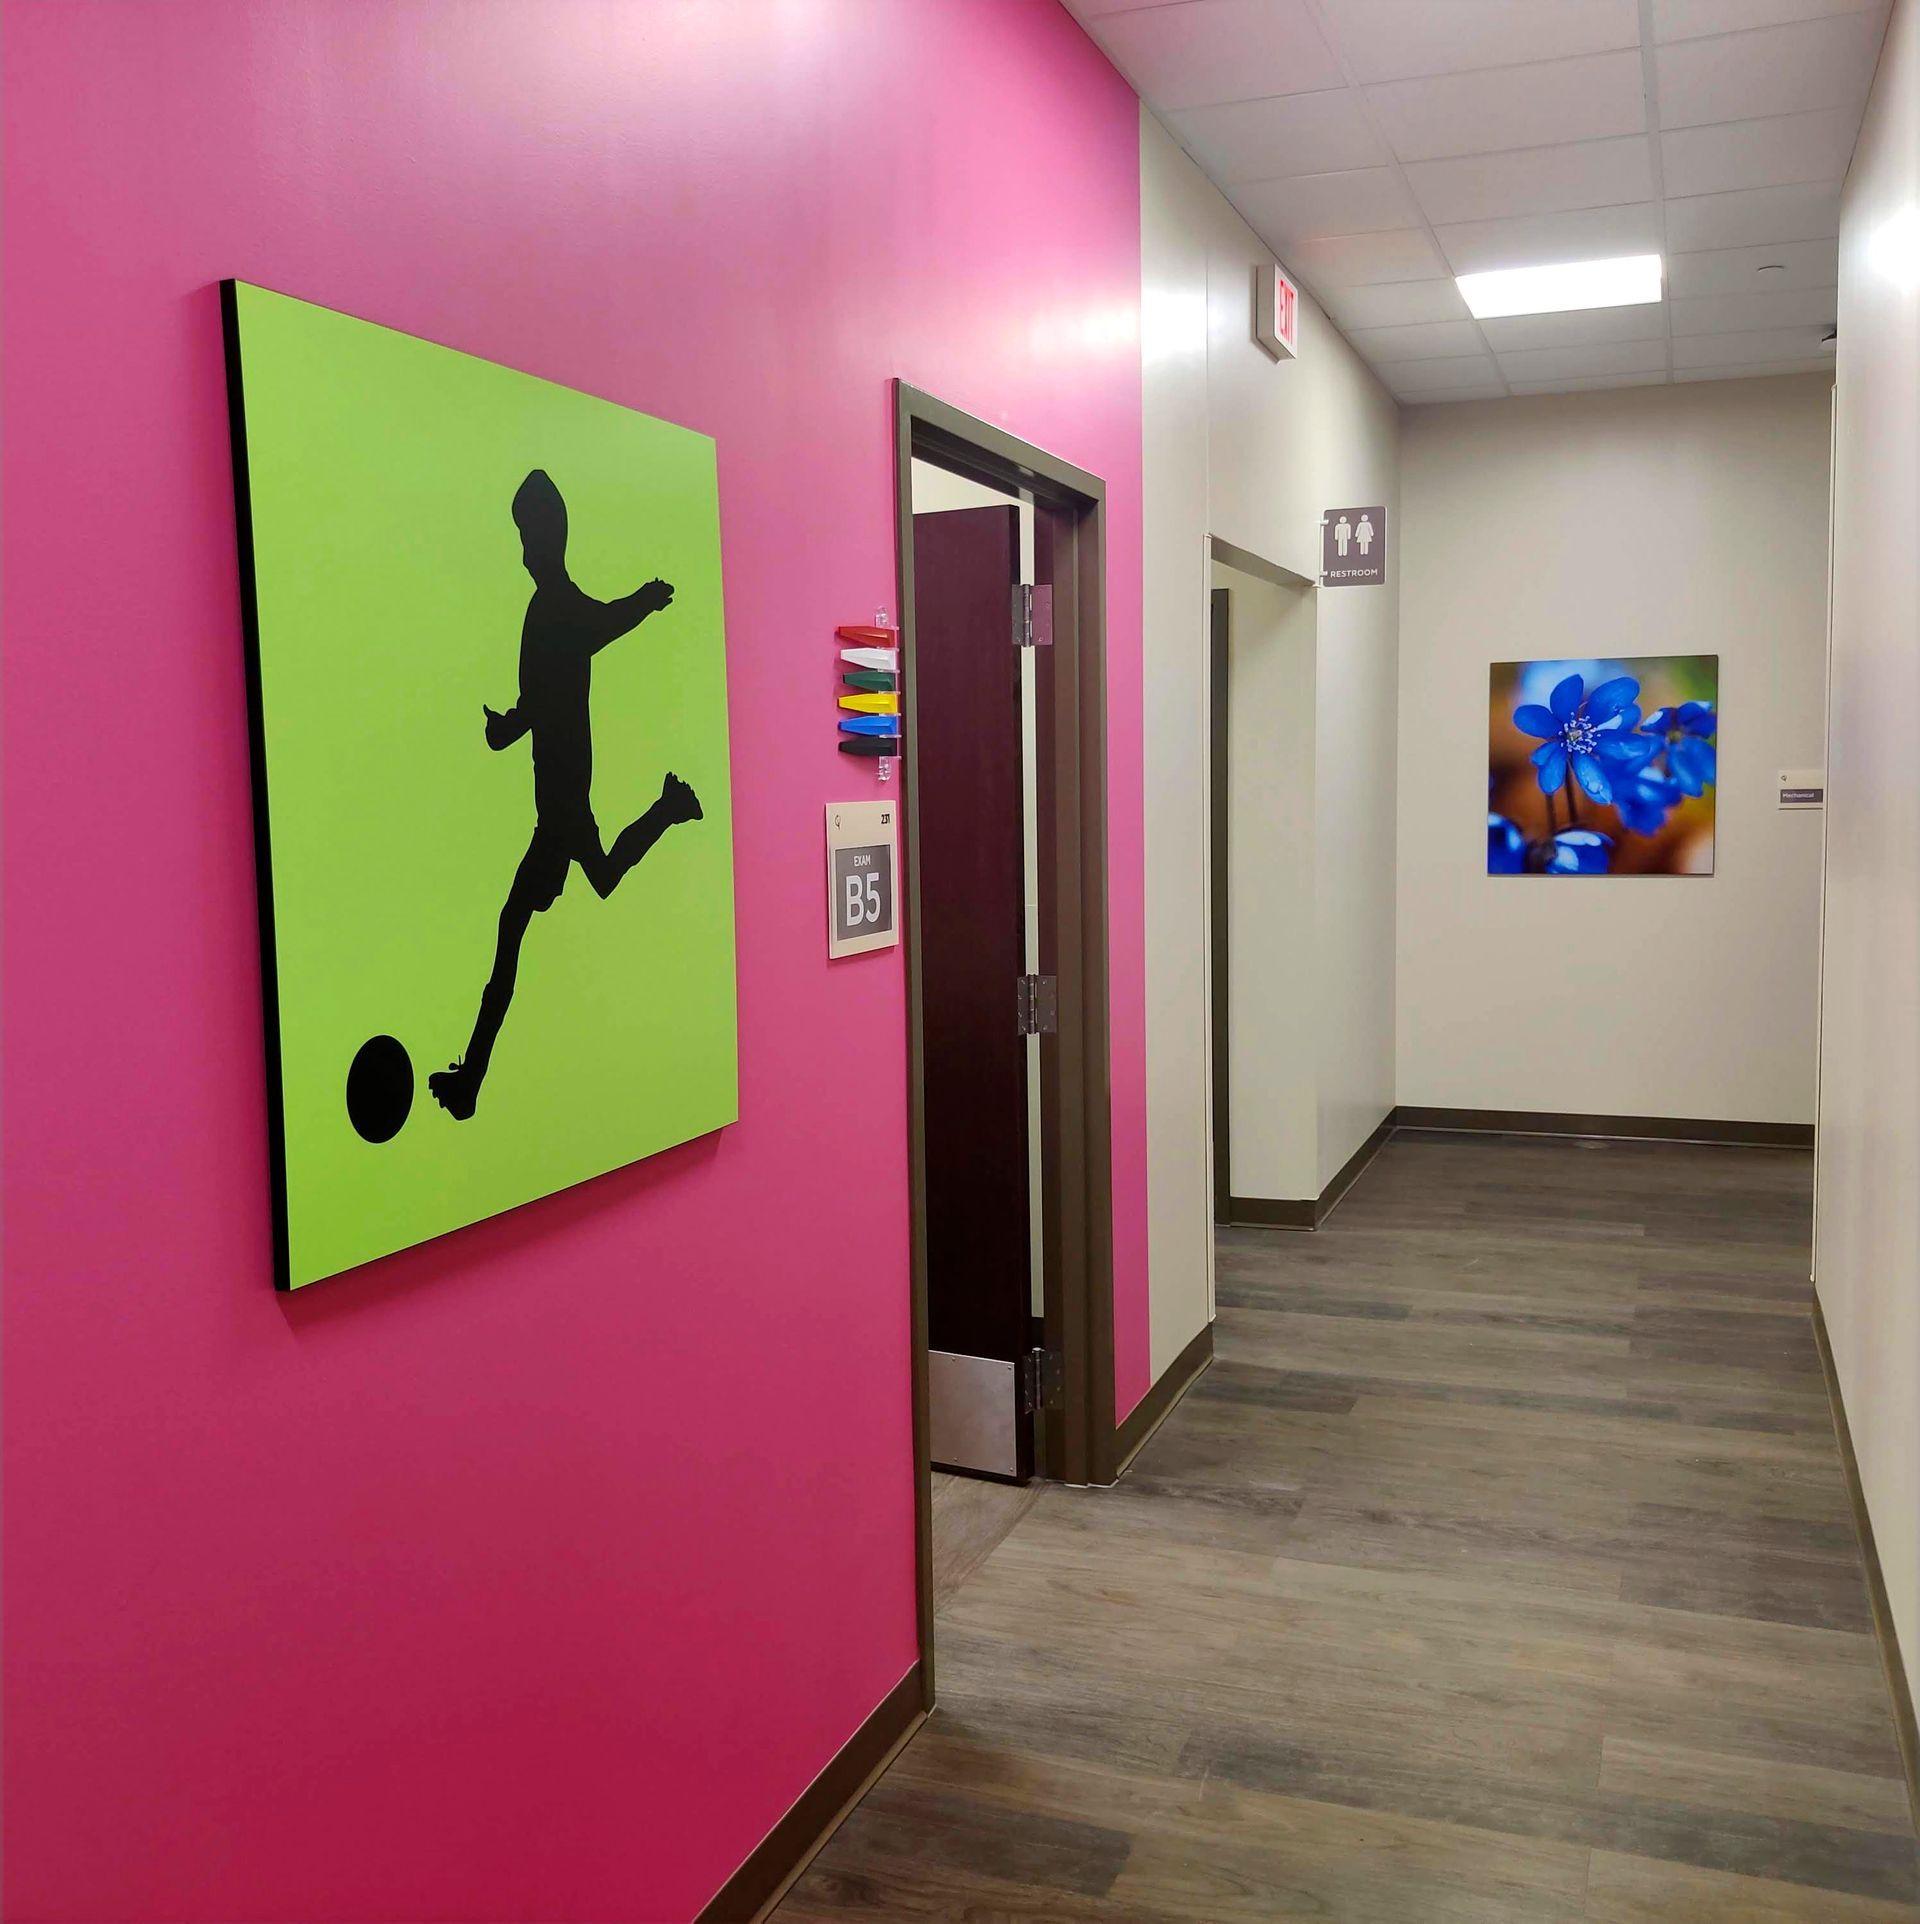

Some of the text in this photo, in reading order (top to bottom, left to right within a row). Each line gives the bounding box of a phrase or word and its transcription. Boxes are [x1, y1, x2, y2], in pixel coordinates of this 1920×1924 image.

[1280, 278, 1295, 346] EXIT
[1330, 568, 1378, 578] RESTROOM
[854, 855, 871, 867] EXAM
[845, 871, 881, 927] B5
